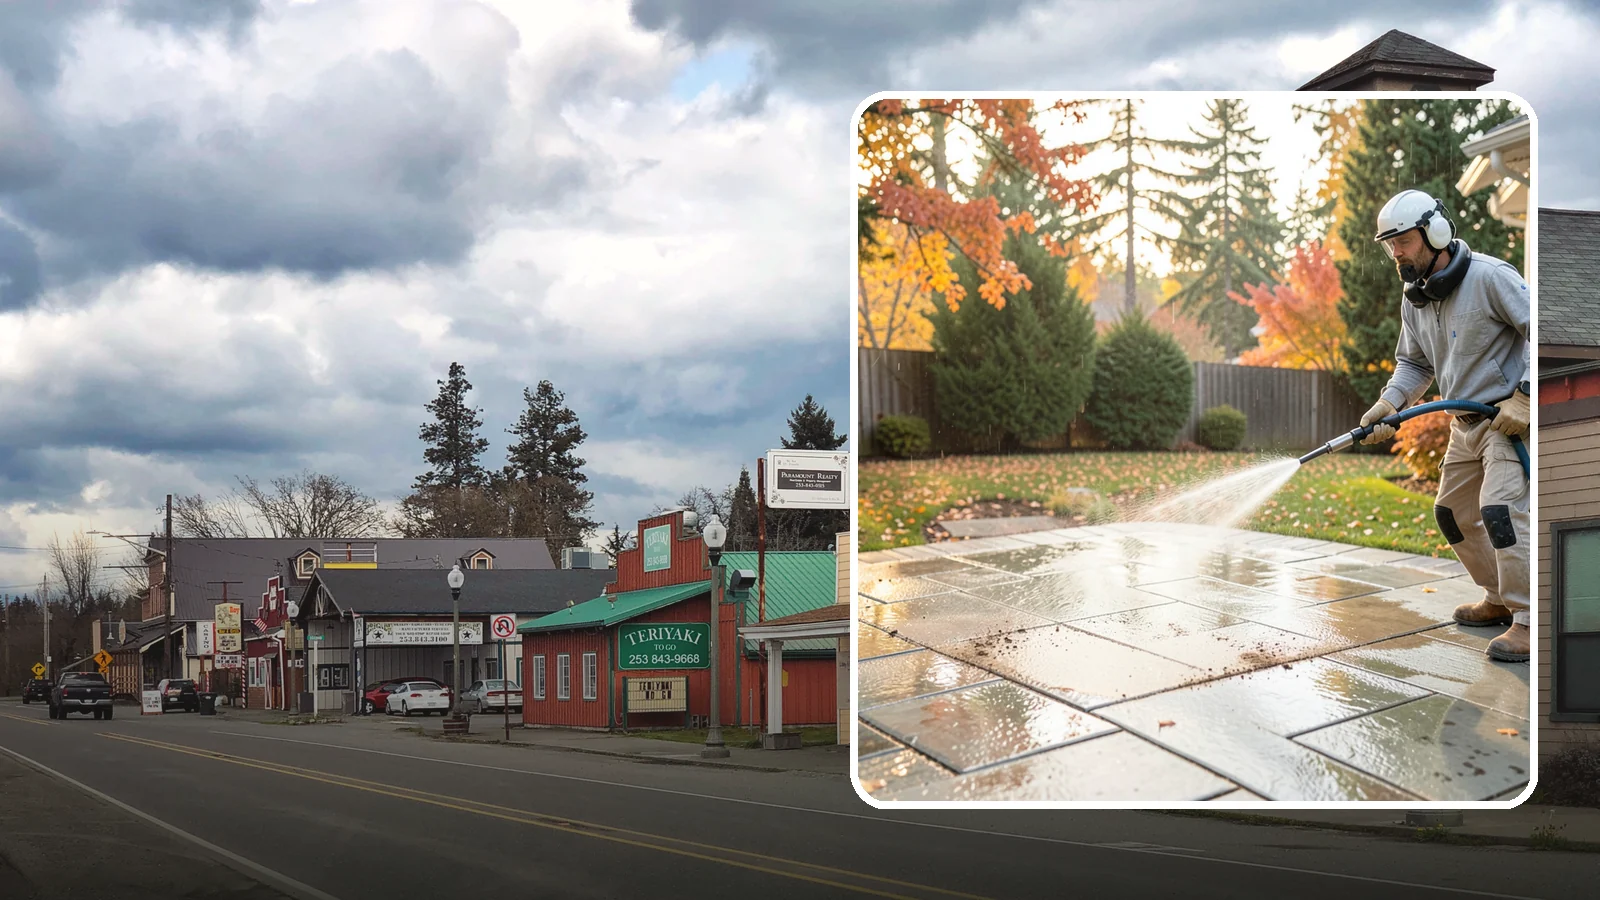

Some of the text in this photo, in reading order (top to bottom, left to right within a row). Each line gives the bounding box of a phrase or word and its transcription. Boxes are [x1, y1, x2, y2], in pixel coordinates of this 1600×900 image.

[781, 471, 839, 480] PARAMOUNT REALTY
[624, 627, 702, 646] TERIYAKI
[654, 643, 677, 651] TO GO
[628, 653, 700, 665] 253 843-9668
